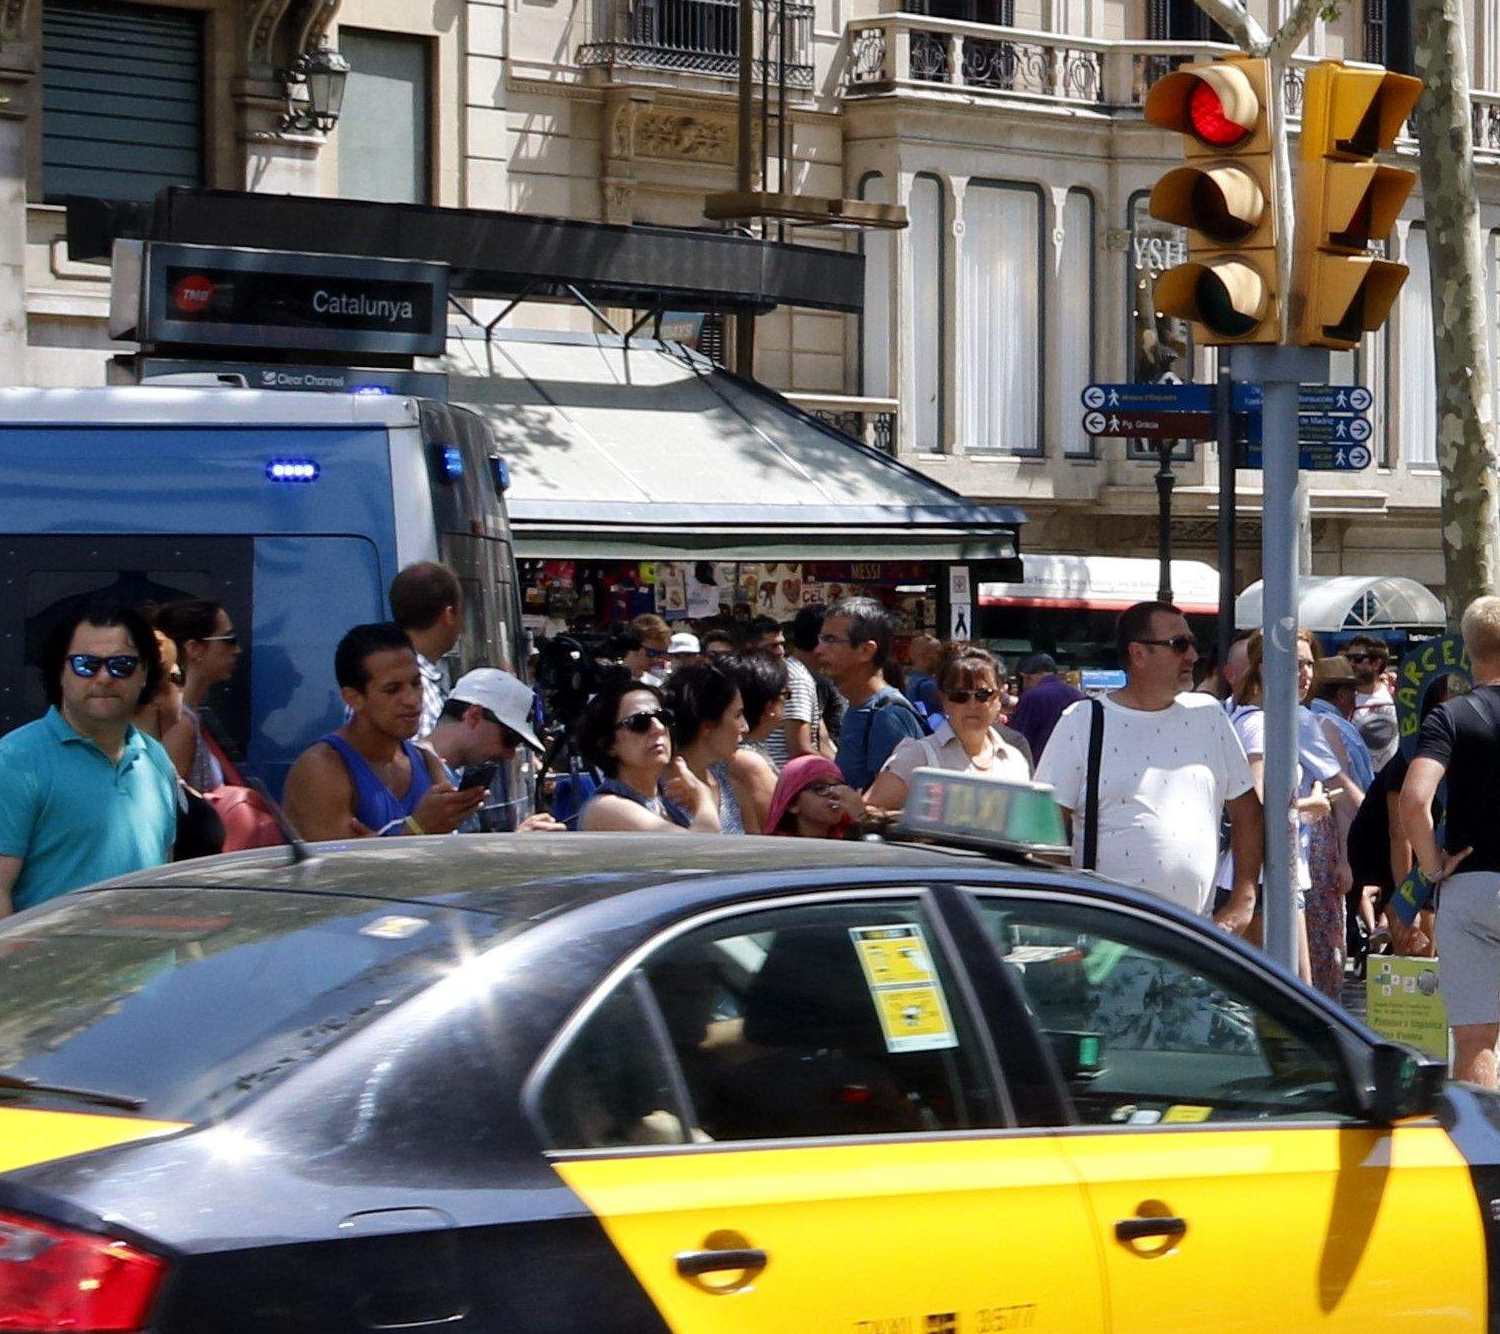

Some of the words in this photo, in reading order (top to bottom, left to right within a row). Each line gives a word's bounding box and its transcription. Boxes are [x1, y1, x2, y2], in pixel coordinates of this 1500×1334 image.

[313, 290, 412, 322] Catalunya
[277, 376, 302, 386] Clear
[304, 376, 345, 387] Channel
